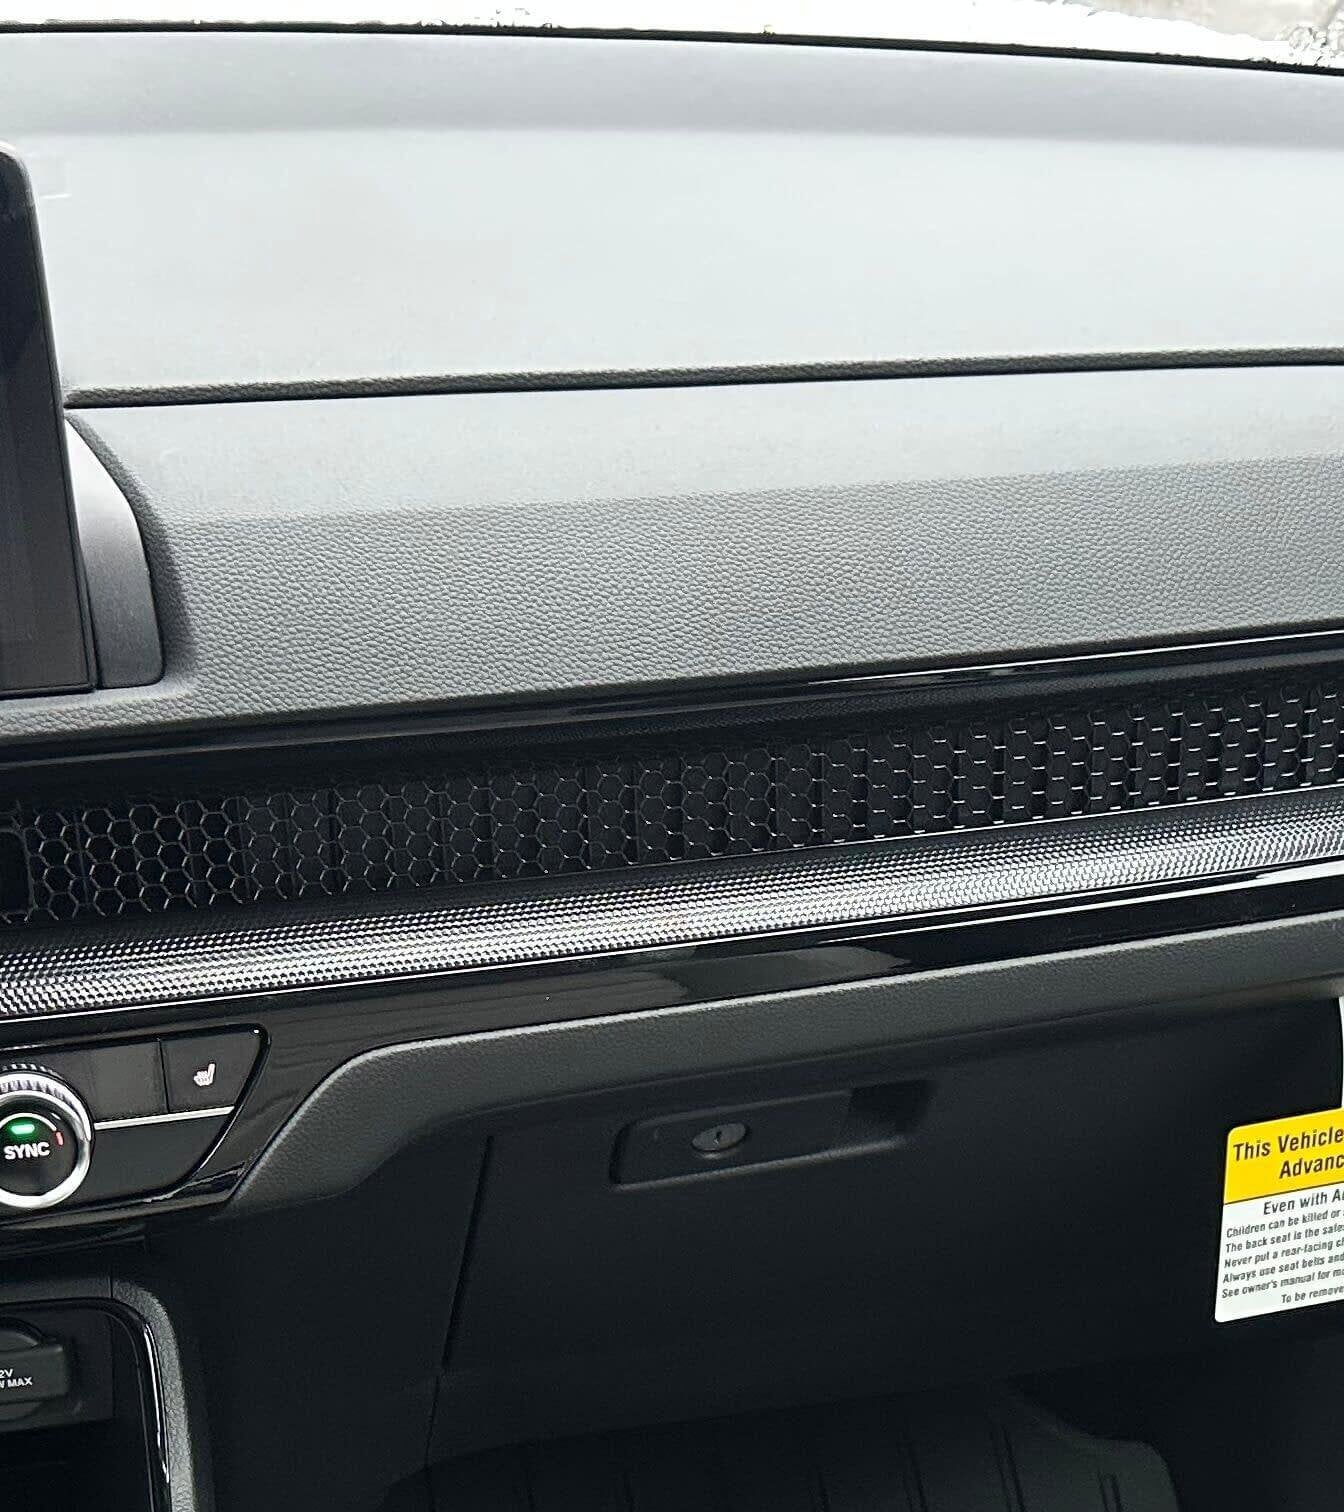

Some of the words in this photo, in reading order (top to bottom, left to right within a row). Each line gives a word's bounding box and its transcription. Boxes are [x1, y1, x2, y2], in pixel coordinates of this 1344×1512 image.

[3, 1141, 50, 1160] SYNC
[1233, 1139, 1271, 1161] This
[1277, 1126, 1344, 1153] Vehicle
[1263, 1199, 1295, 1215] Even
[1299, 1191, 1328, 1208] with
[1226, 1224, 1266, 1238] Children
[1268, 1219, 1285, 1230] can
[1287, 1216, 1299, 1227] be
[1302, 1210, 1328, 1224] killed
[1330, 1209, 1341, 1219] or
[1226, 1242, 1243, 1253] The
[1245, 1236, 1268, 1250] back
[1270, 1232, 1291, 1245] seat
[1293, 1230, 1302, 1241] is
[1304, 1227, 1319, 1239] the
[1222, 1270, 1257, 1284] Always
[1259, 1266, 1276, 1277] use
[1278, 1260, 1300, 1273] seat
[1301, 1256, 1325, 1269] belts
[1327, 1251, 1344, 1264] and
[1224, 1256, 1253, 1268] Never
[1254, 1251, 1270, 1265] put
[1272, 1250, 1279, 1259] a
[1281, 1240, 1333, 1258] rear-facing
[1222, 1288, 1239, 1299] See
[1242, 1279, 1278, 1295] owner's
[1280, 1272, 1316, 1287] manual
[1317, 1270, 1331, 1281] for
[1281, 1293, 1292, 1304] To
[1294, 1291, 1306, 1301] be
[7, 1376, 33, 1388] MAX
